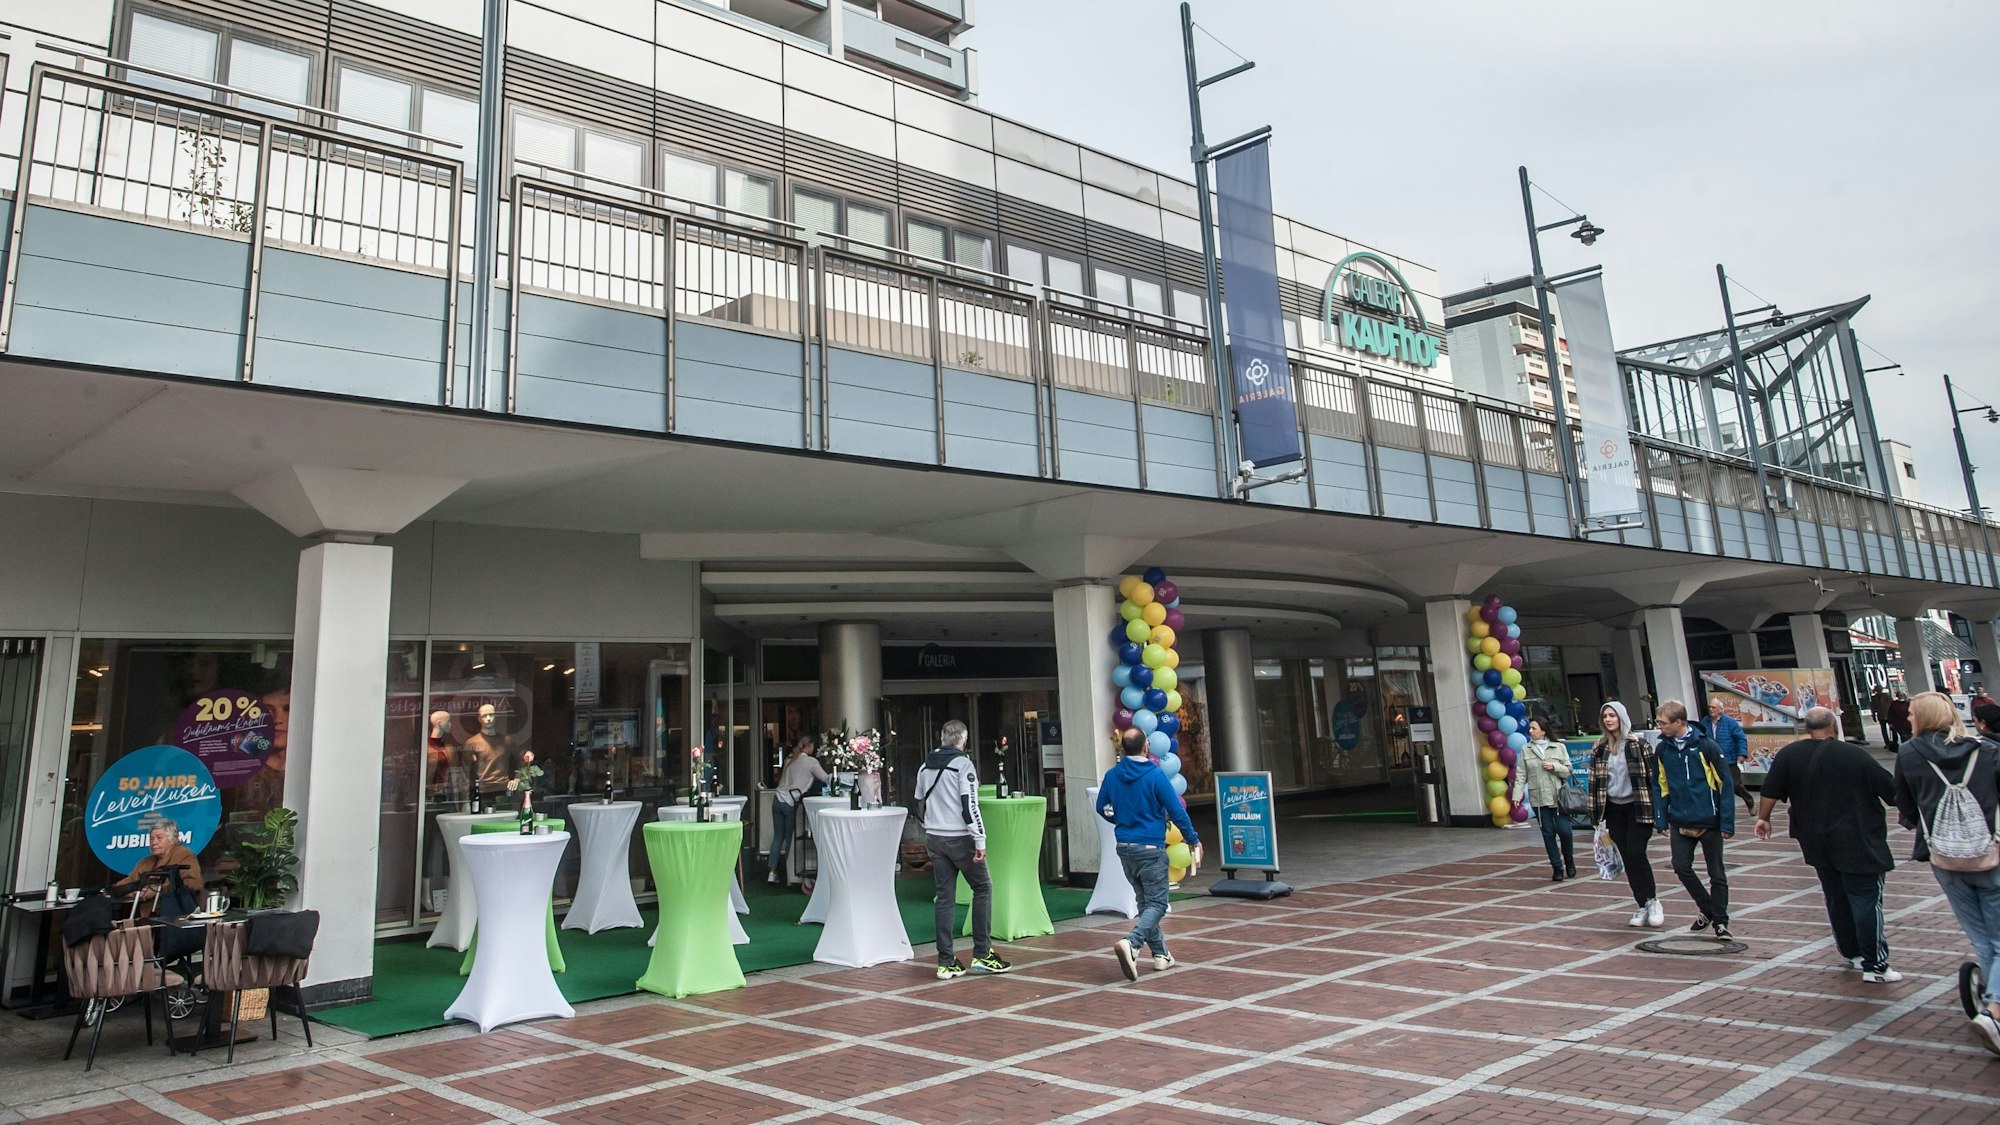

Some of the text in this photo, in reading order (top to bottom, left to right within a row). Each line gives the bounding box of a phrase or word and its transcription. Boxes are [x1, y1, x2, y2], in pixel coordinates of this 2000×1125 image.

[1348, 271, 1403, 313] GALERIA
[924, 654, 957, 668] GALERIA
[195, 696, 261, 721] 20 %
[118, 775, 197, 791] 50 JAHRE
[1229, 810, 1262, 820] JUBILÄUM
[106, 830, 191, 850] JUBIM
